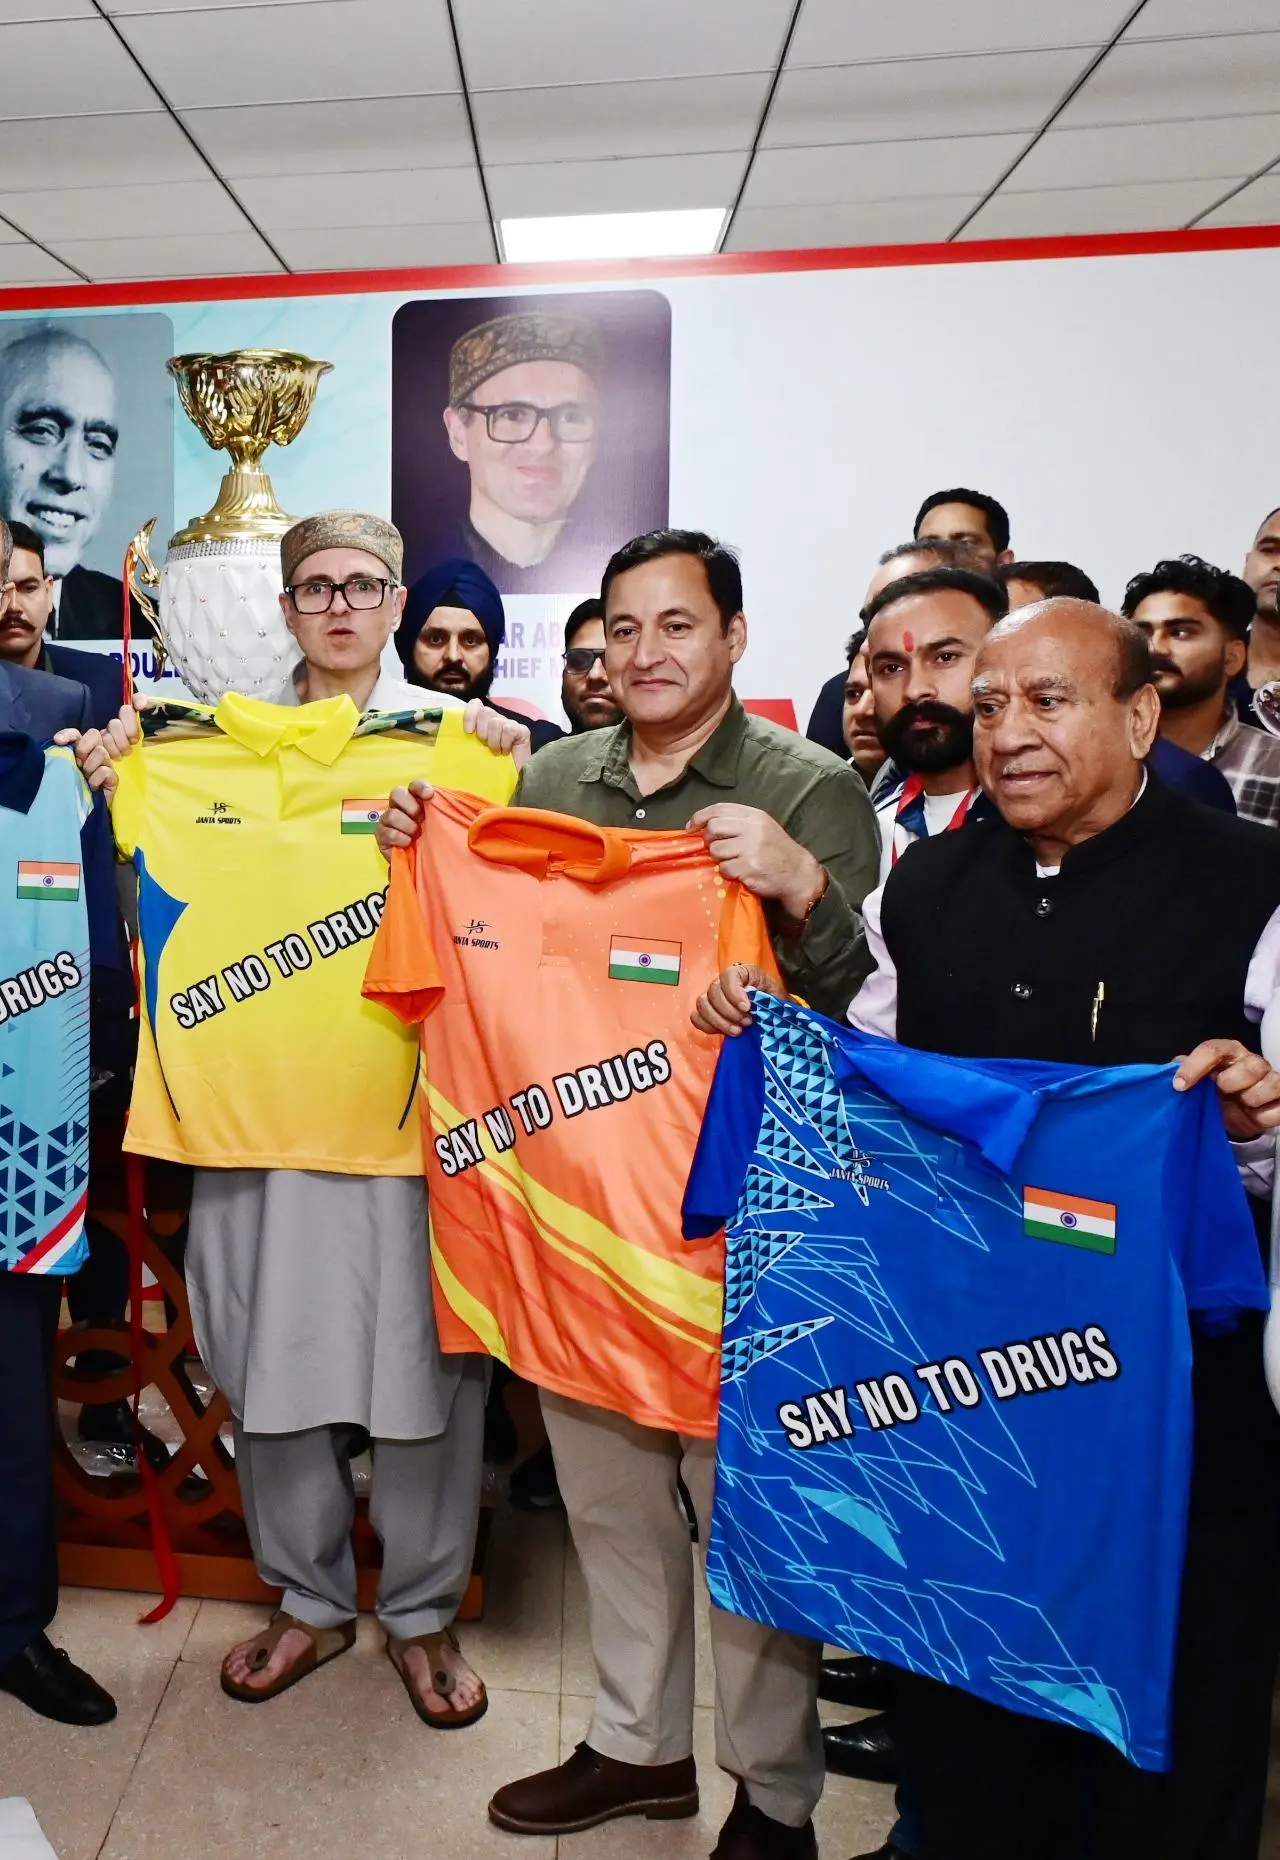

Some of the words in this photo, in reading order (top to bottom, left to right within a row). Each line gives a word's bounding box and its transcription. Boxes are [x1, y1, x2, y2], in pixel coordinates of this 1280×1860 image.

[493, 657, 541, 679] HIEF
[195, 816, 216, 824] JANTA
[217, 817, 242, 825] SPORTS
[452, 935, 469, 946] ANTA
[470, 938, 500, 951] SPORTS
[170, 975, 226, 1029] SAY
[221, 955, 270, 1003] NO
[264, 933, 312, 978] TO
[307, 885, 391, 958] DRUG
[433, 1118, 485, 1177] SAY
[510, 1083, 553, 1135] TO
[552, 1039, 672, 1119] DRUGS
[829, 1168, 857, 1184] JANTA
[858, 1174, 890, 1191] SPORTS
[777, 1388, 855, 1450] SAY
[853, 1372, 920, 1431] NO
[915, 1357, 982, 1413] TO
[978, 1325, 1120, 1401] DRUGS
